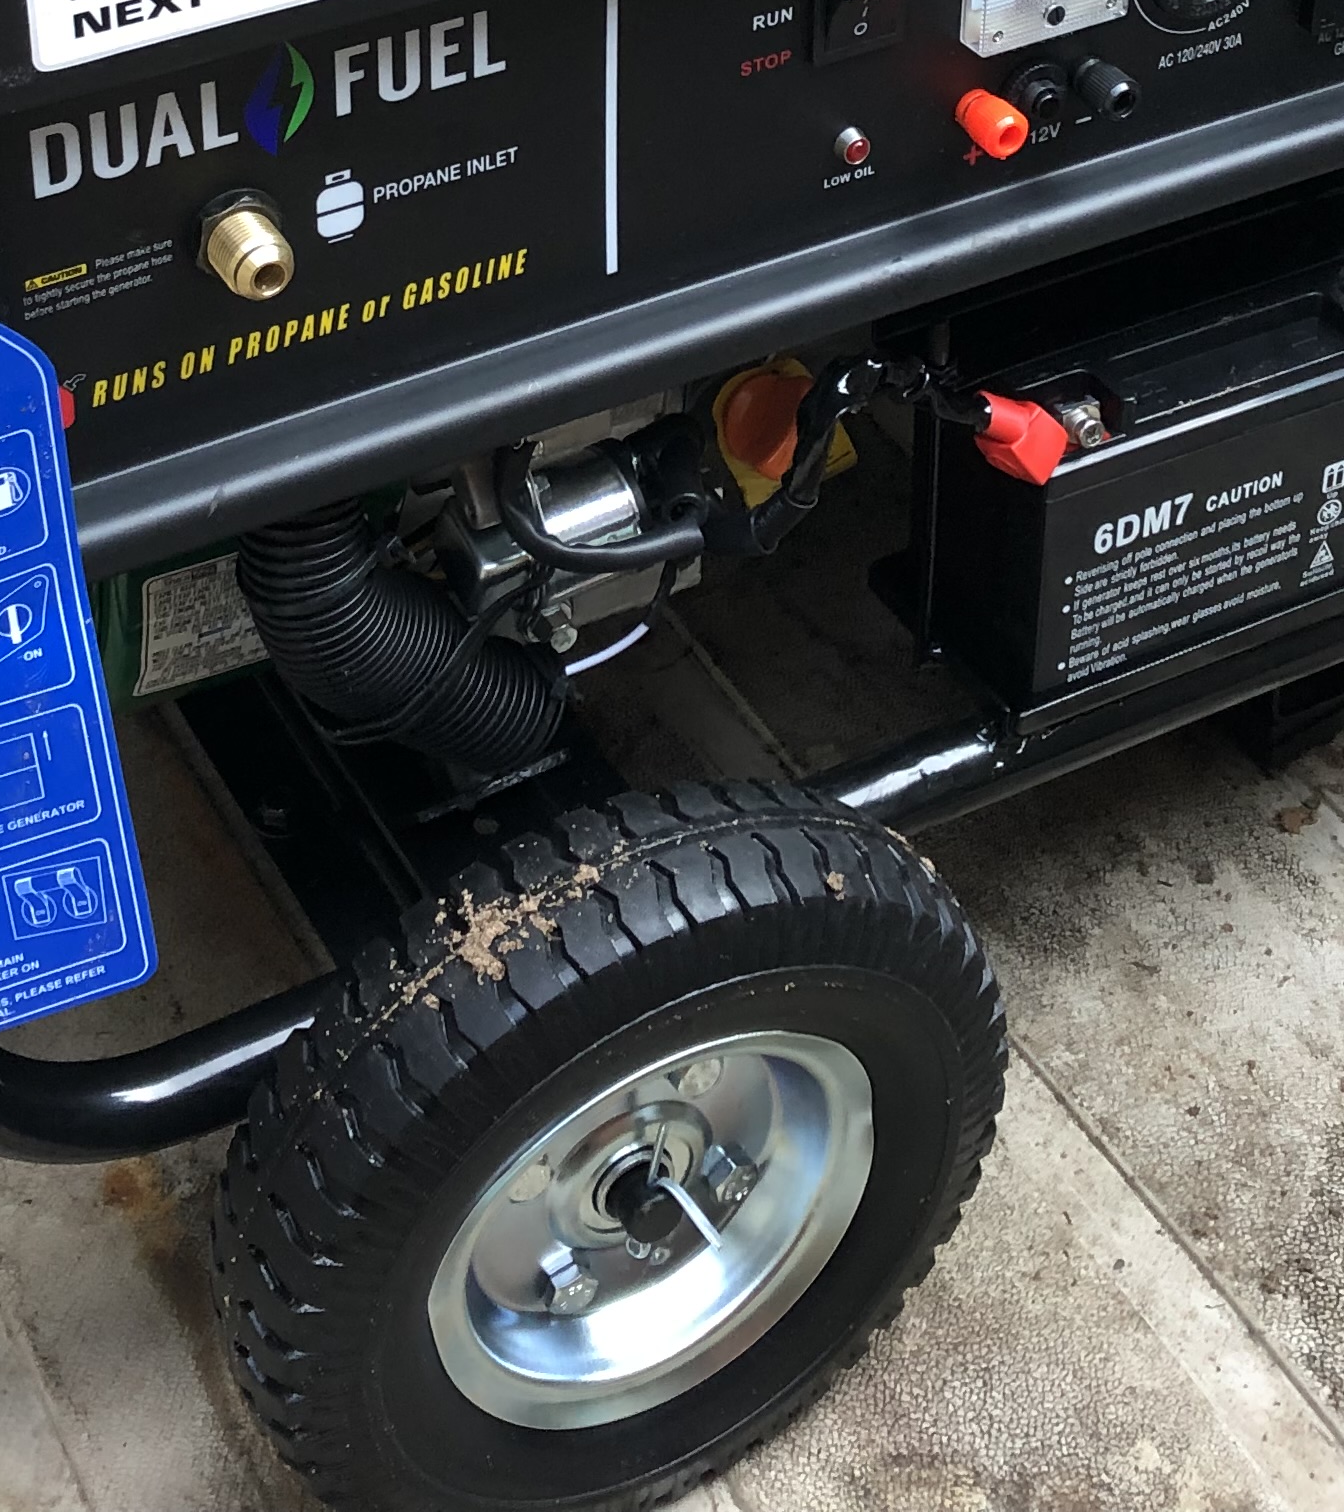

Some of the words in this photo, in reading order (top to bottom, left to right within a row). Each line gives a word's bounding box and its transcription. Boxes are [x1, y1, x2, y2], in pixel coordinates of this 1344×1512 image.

[753, 6, 792, 30] RUN
[741, 50, 791, 75] STOP
[1158, 53, 1173, 68] AC
[1177, 38, 1221, 62] 120/240V
[1223, 33, 1241, 49] 30A
[30, 82, 238, 198] DUAL
[335, 11, 505, 116] FUEL
[1030, 122, 1060, 144] 12V
[373, 163, 460, 202] PROPANE
[467, 147, 515, 175] INLET
[824, 172, 850, 188] LOW
[854, 166, 874, 178] OIL
[41, 267, 86, 283] CAUTION
[93, 361, 165, 406] RUNS
[181, 345, 214, 378] ON
[228, 303, 349, 363] PROPANE
[362, 295, 389, 321] or
[403, 248, 526, 309] GASOLINE
[1094, 493, 1193, 554] 6DM7
[1206, 472, 1282, 511] CAUTION
[23, 648, 42, 660] ON
[7, 800, 84, 829] GENERATOR
[21, 960, 38, 972] ON
[15, 979, 61, 1001] PLEASE
[65, 965, 104, 984] REFER
